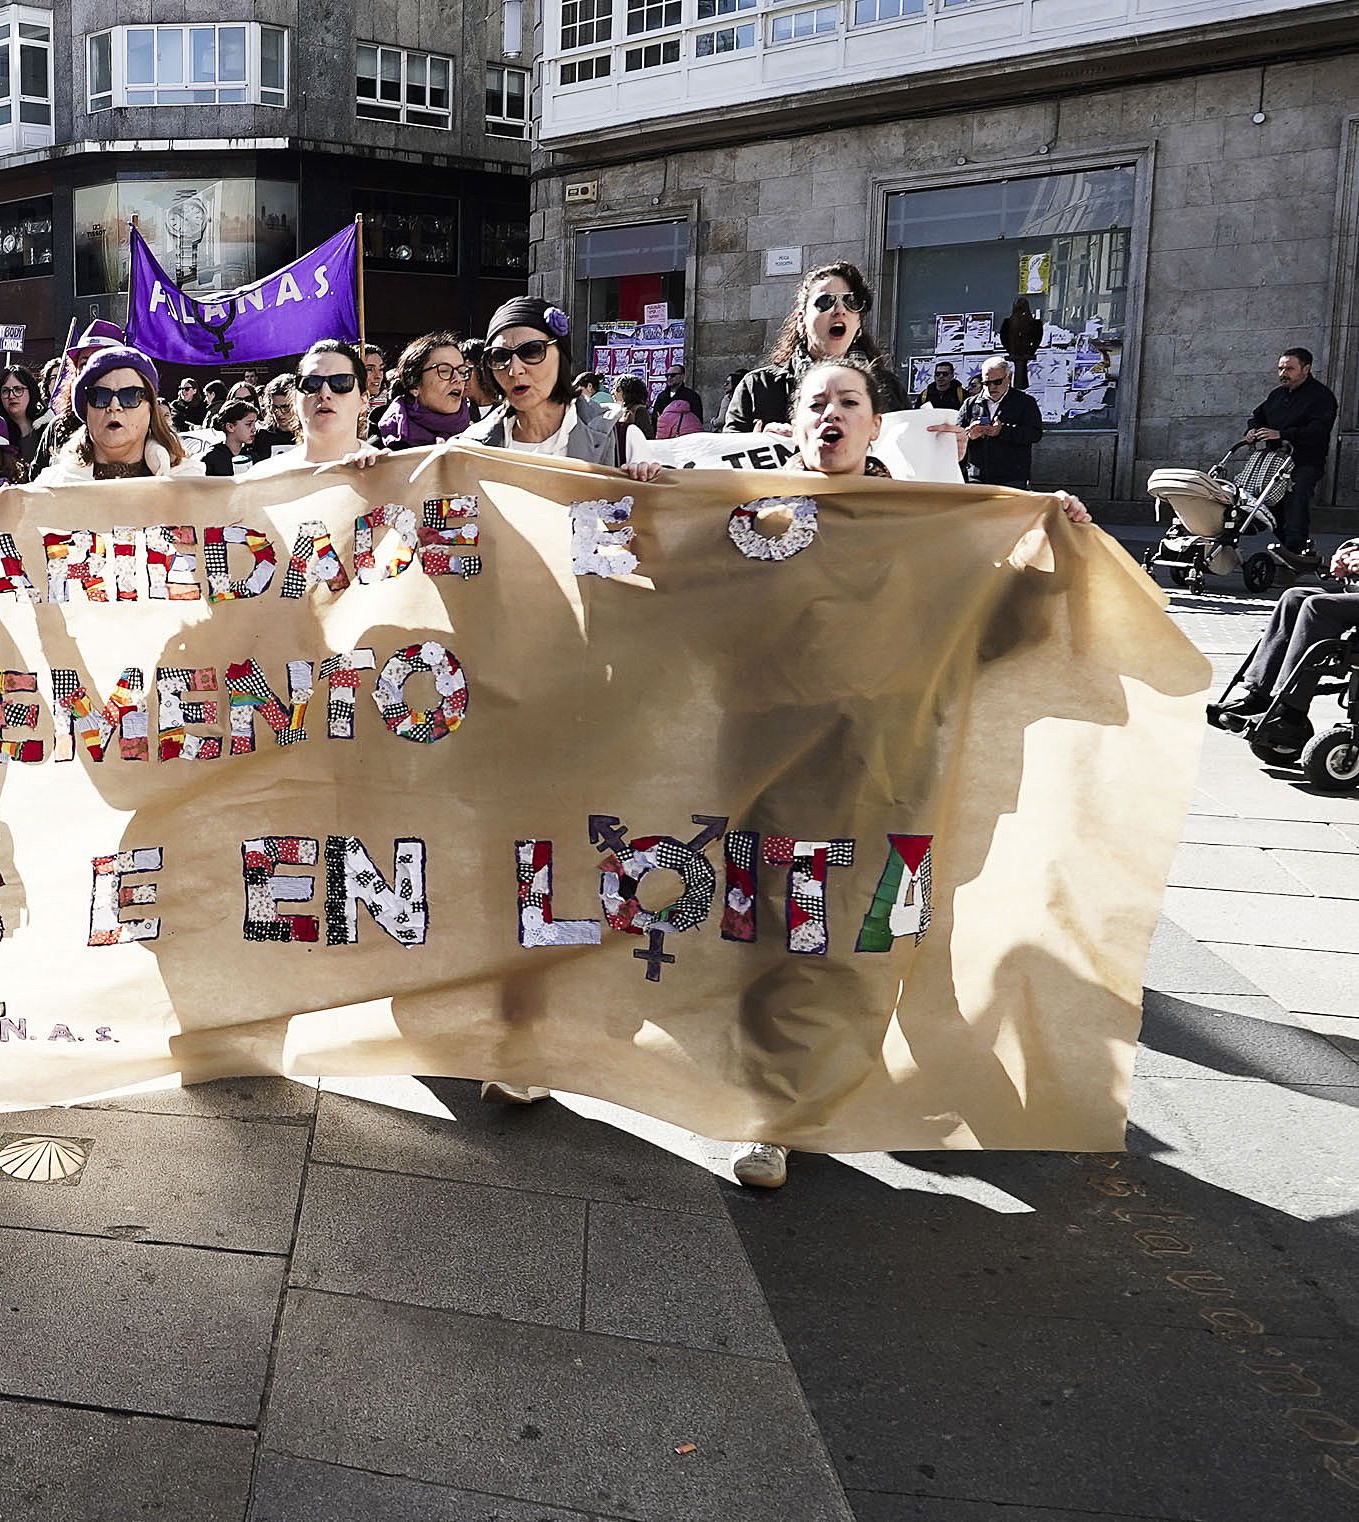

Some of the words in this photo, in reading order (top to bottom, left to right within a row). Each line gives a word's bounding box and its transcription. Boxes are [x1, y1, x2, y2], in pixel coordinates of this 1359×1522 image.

[569, 495, 640, 578] E
[729, 495, 818, 561] O
[87, 846, 163, 947] E
[241, 835, 429, 949] EN
[515, 829, 934, 954] LOITA
